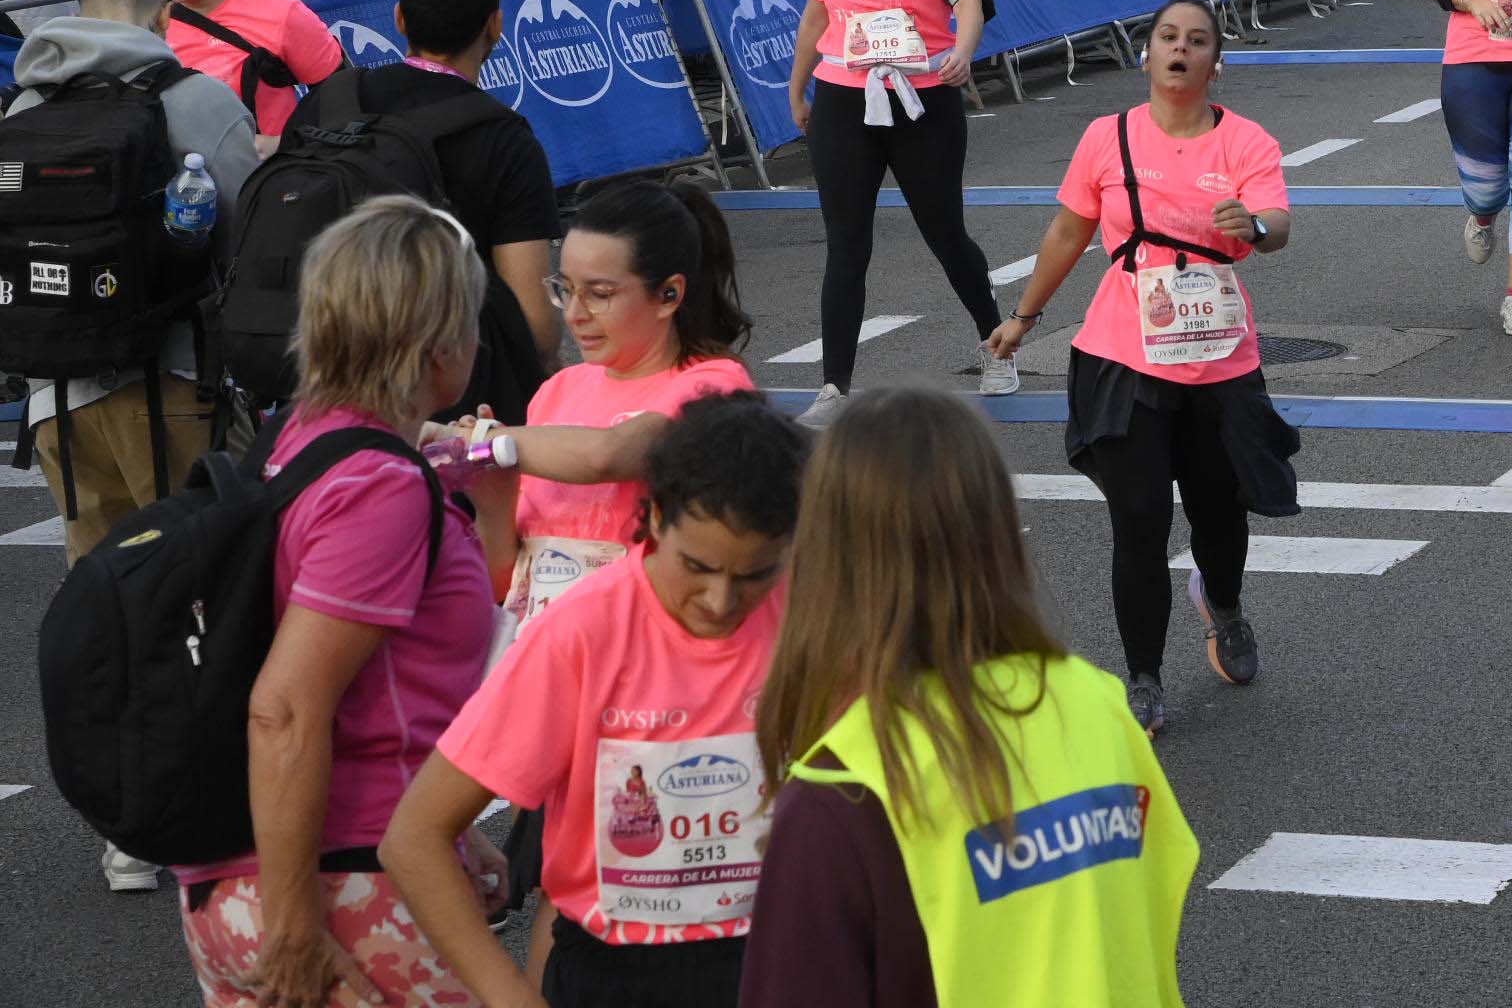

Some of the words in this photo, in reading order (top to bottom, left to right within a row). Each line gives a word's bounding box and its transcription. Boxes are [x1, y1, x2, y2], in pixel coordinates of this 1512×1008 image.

[617, 21, 676, 64] ASTUR
[872, 37, 899, 50] 016
[524, 36, 608, 81] ASTURIANA
[1120, 167, 1162, 179] SHO
[33, 266, 44, 278] ALL
[48, 267, 57, 278] OR
[33, 281, 67, 292] NOTHING
[1179, 301, 1214, 317] 016
[1183, 320, 1210, 329] 31981
[1156, 334, 1186, 343] CARRERA
[1187, 333, 1195, 341] DE
[603, 708, 687, 729] OYSHO
[666, 771, 743, 790] ASTURIANA
[670, 811, 740, 840] 016
[683, 845, 727, 864] 5513
[622, 873, 679, 884] CARRERA
[683, 871, 699, 881] DE
[701, 869, 717, 881] LA
[720, 866, 760, 879] MUJER
[618, 894, 681, 913] OYSHO
